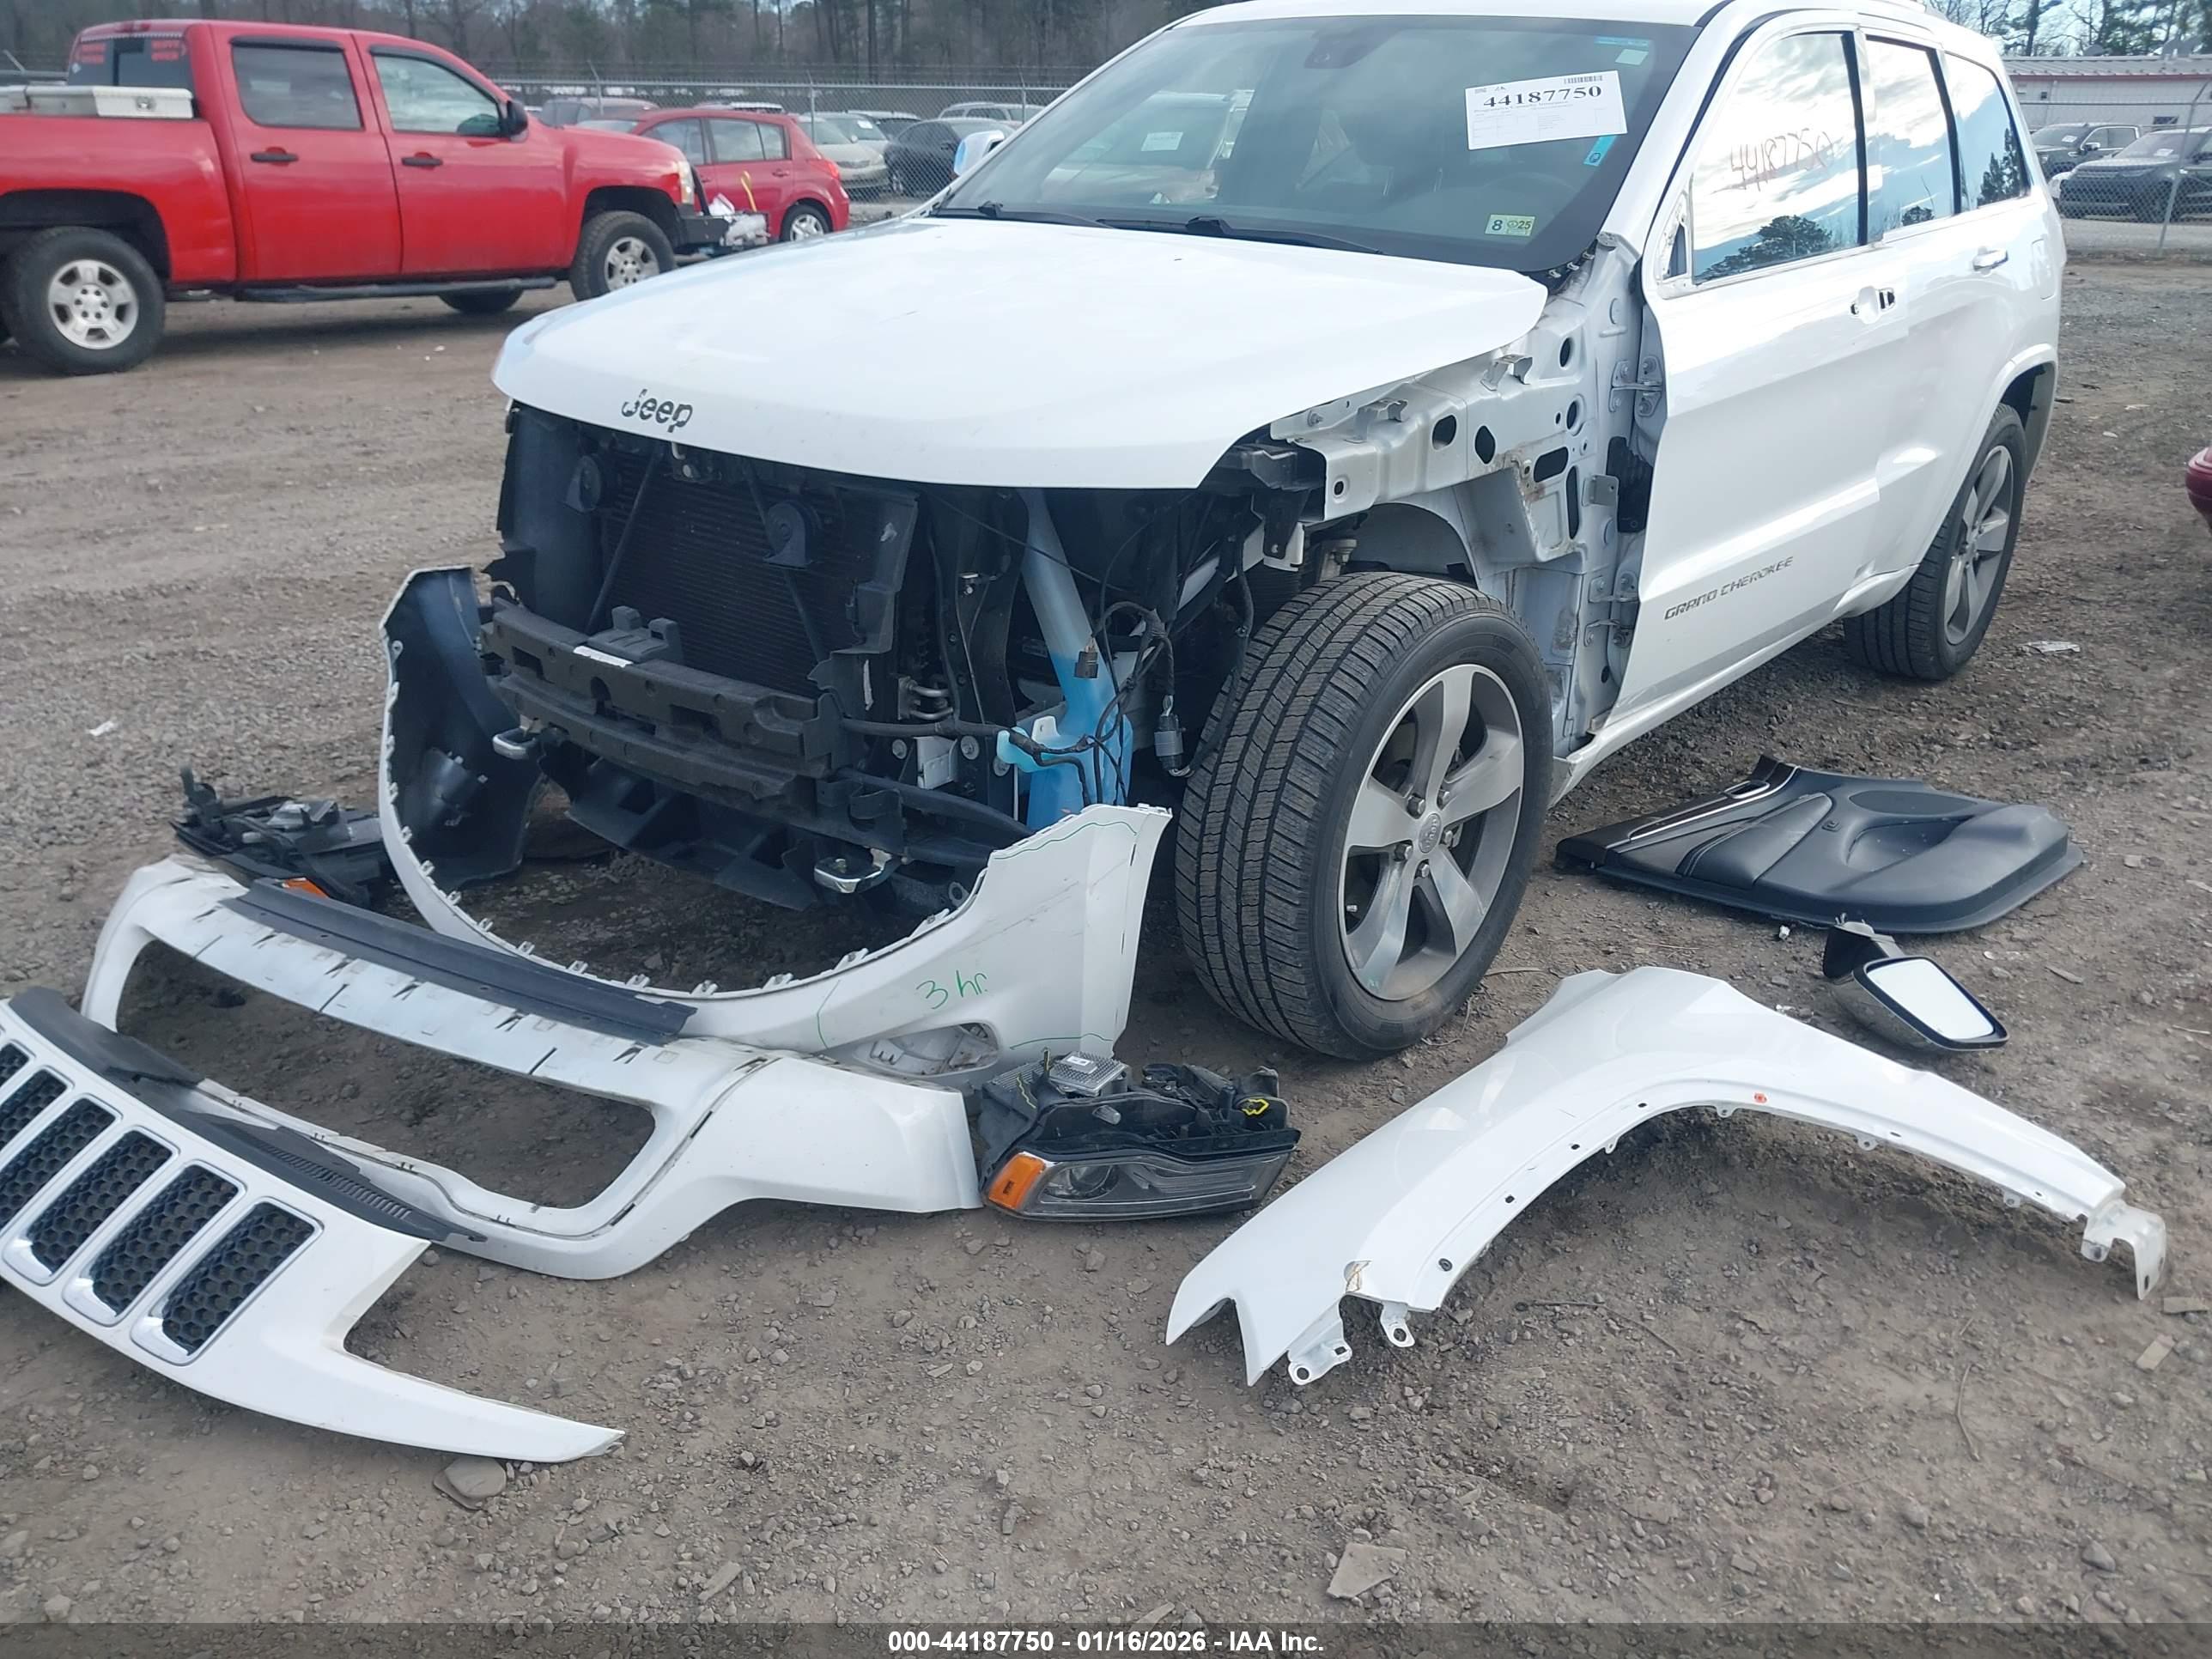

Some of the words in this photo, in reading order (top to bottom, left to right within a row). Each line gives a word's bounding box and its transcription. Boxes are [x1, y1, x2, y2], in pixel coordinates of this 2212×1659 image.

[1483, 85, 1602, 107] 44187750
[1491, 219, 1504, 231] 8
[1517, 220, 1533, 230] 25
[620, 387, 694, 434] Jeep
[1663, 588, 1719, 621] GRAND
[1719, 556, 1795, 597] CHEROKEE
[915, 979, 949, 1010] 3
